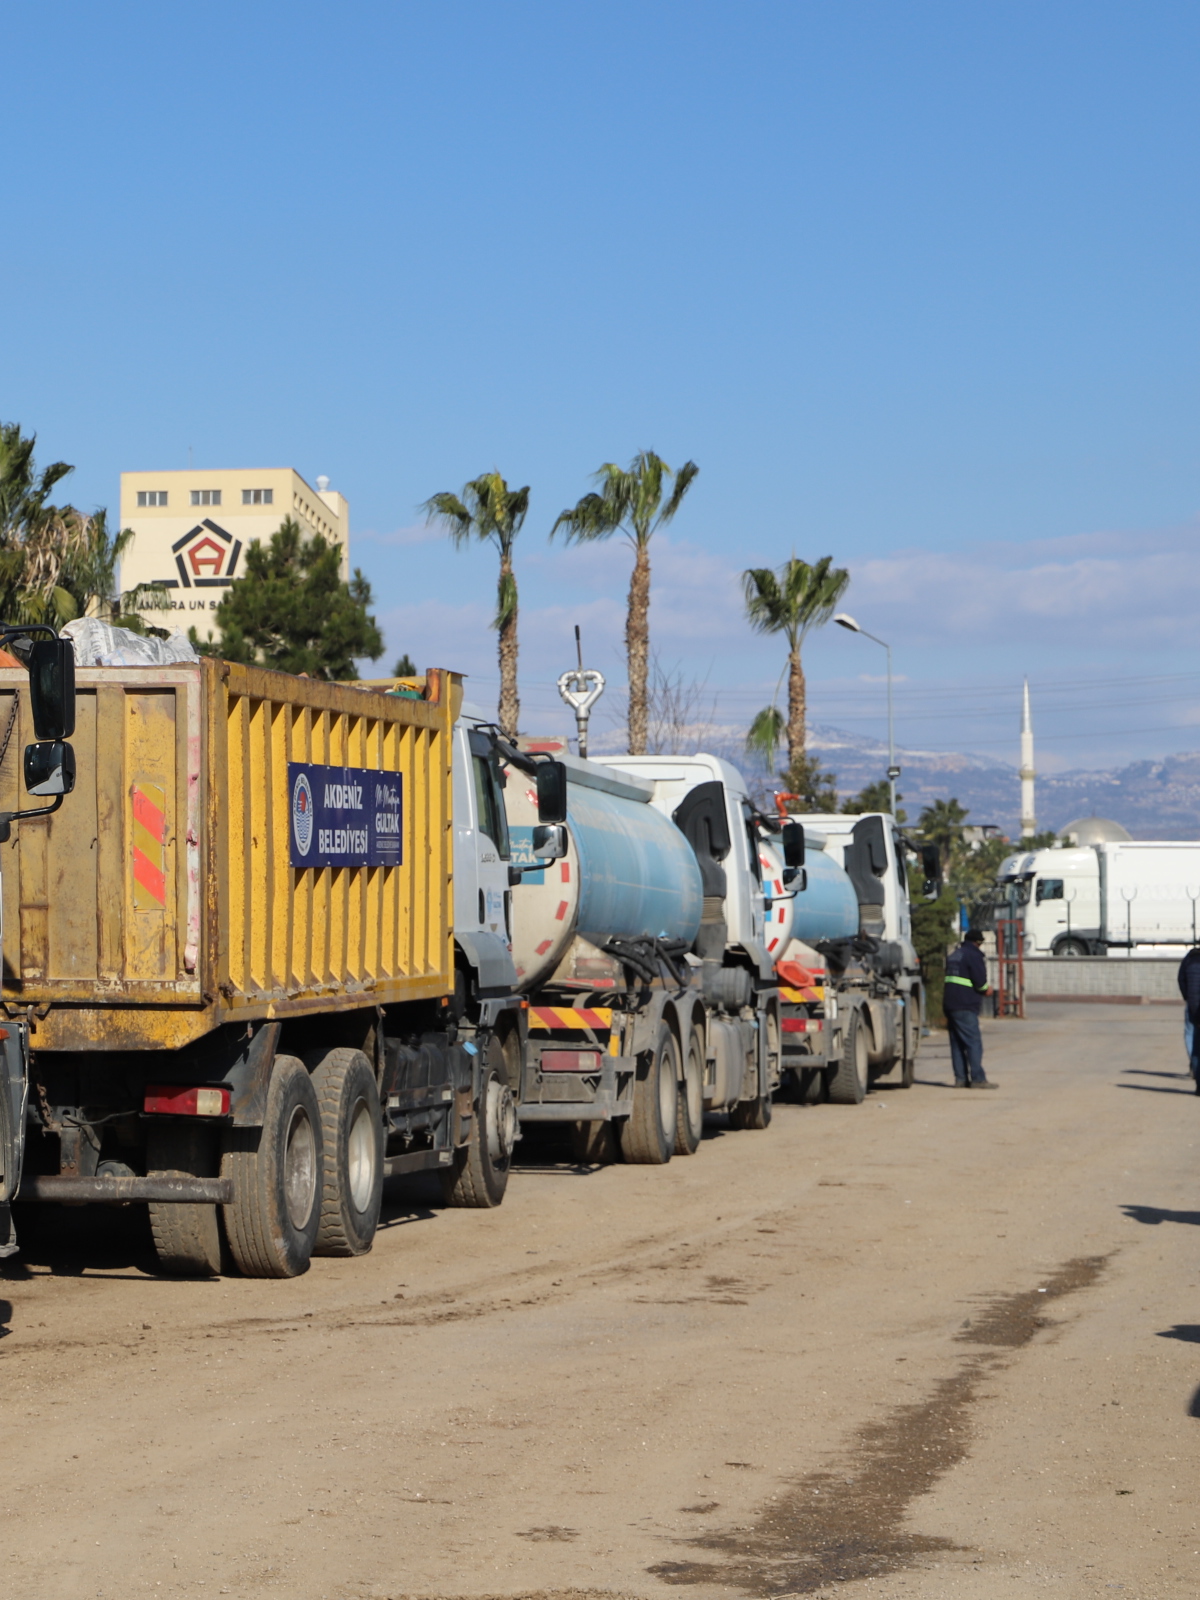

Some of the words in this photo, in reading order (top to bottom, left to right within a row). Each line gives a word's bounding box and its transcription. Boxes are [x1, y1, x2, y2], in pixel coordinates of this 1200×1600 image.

[137, 600, 186, 610] ANKRA
[189, 600, 205, 610] UN
[324, 780, 363, 810] AKDENİZ
[319, 824, 368, 854] BELEDİYESİ
[510, 852, 538, 863] TAK
